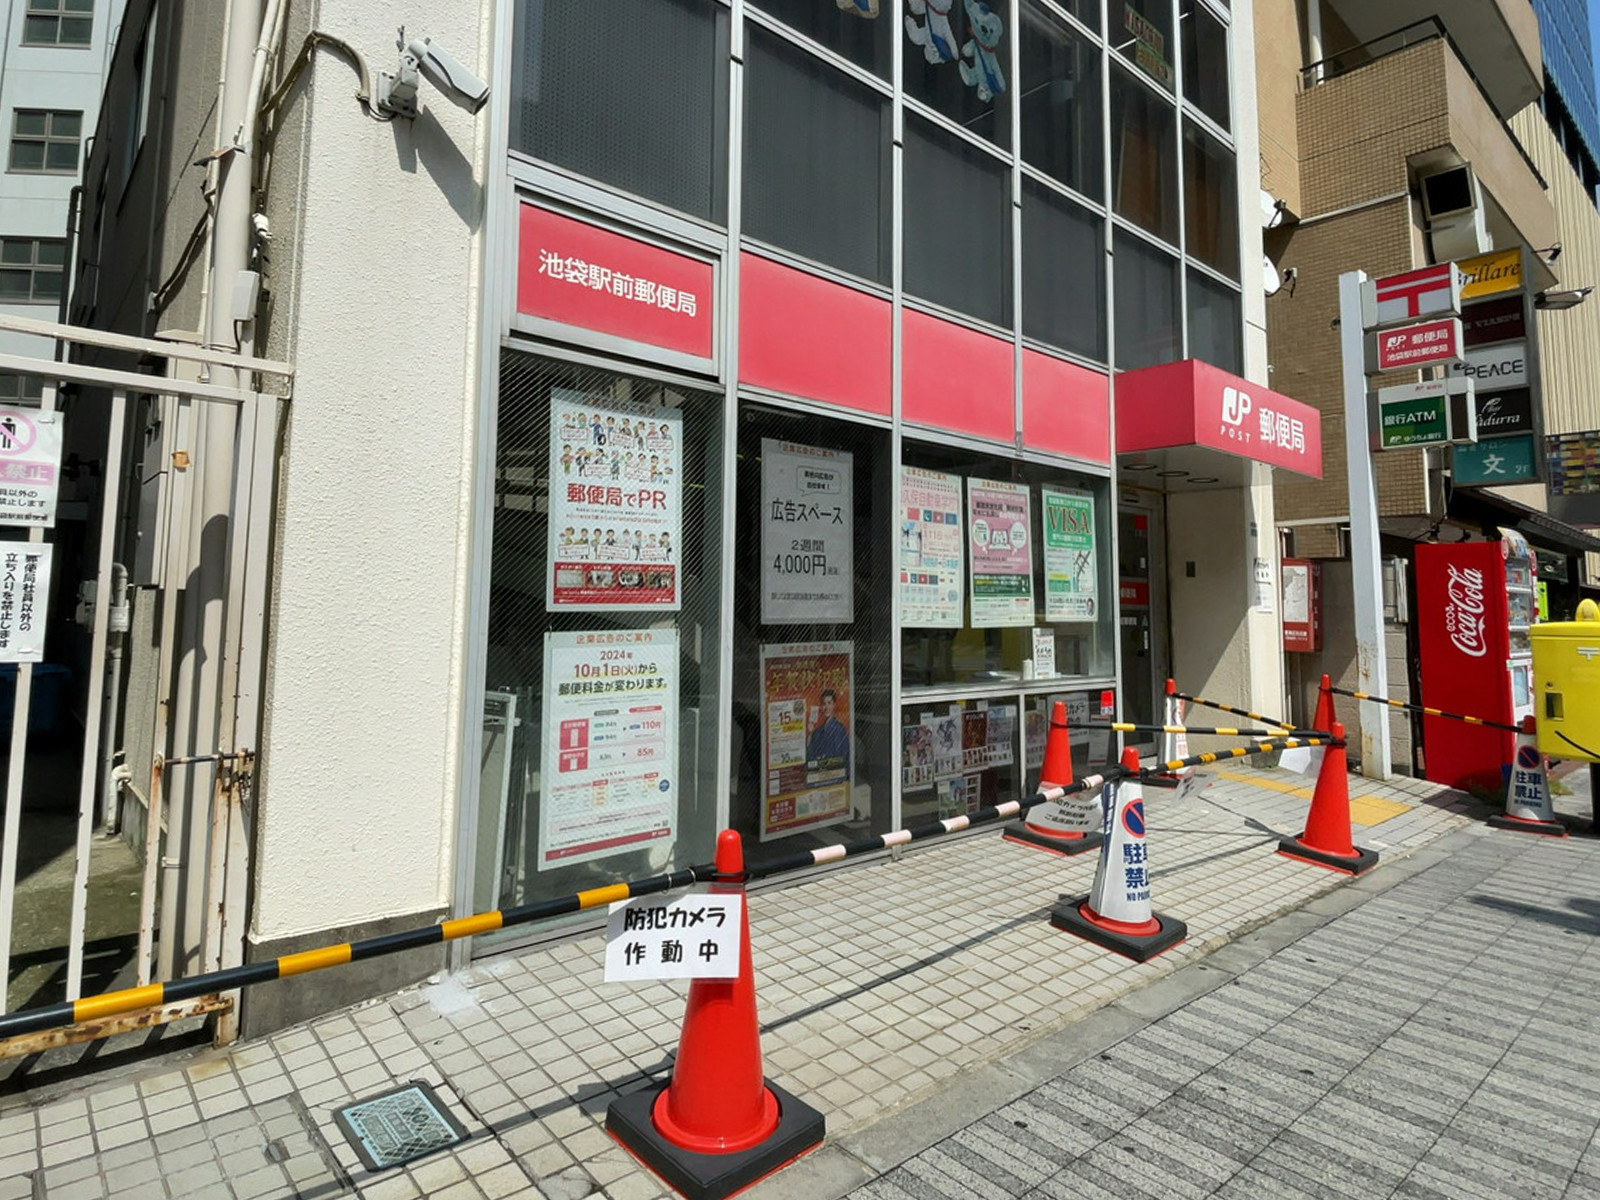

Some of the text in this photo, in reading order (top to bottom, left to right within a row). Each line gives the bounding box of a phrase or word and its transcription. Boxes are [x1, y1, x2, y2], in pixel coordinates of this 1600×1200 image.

[538, 249, 697, 317] 池袋駅前郵便局
[1411, 328, 1449, 345] 郵便局
[1386, 344, 1449, 362] 池袋駅前郵便局
[1464, 359, 1524, 381] PEACE
[1384, 410, 1437, 426] 銀行ATM
[1220, 425, 1251, 443] POST
[1258, 407, 1305, 455] 郵便局
[1403, 432, 1443, 443] ゆうちょ銀行
[1482, 453, 1506, 475] 文
[566, 482, 667, 510] 郵便局でPR
[771, 497, 843, 525] 広告スペース
[1048, 506, 1092, 535] VISA
[791, 539, 824, 553] 2週間
[773, 554, 827, 576] 4,000円
[1447, 563, 1488, 657] Coca-Cola
[576, 633, 653, 645] 企業広告のご案内
[600, 650, 633, 661] 2024年
[574, 662, 658, 678] 10月1日(火)から
[558, 677, 668, 696] 郵便料金が変わります。
[642, 720, 662, 730] 110円
[636, 747, 655, 758] 85円
[1515, 771, 1542, 785] 駐車
[1515, 785, 1542, 800] 禁止
[624, 906, 726, 931] 防犯カメラ
[624, 939, 719, 966] 作動中
